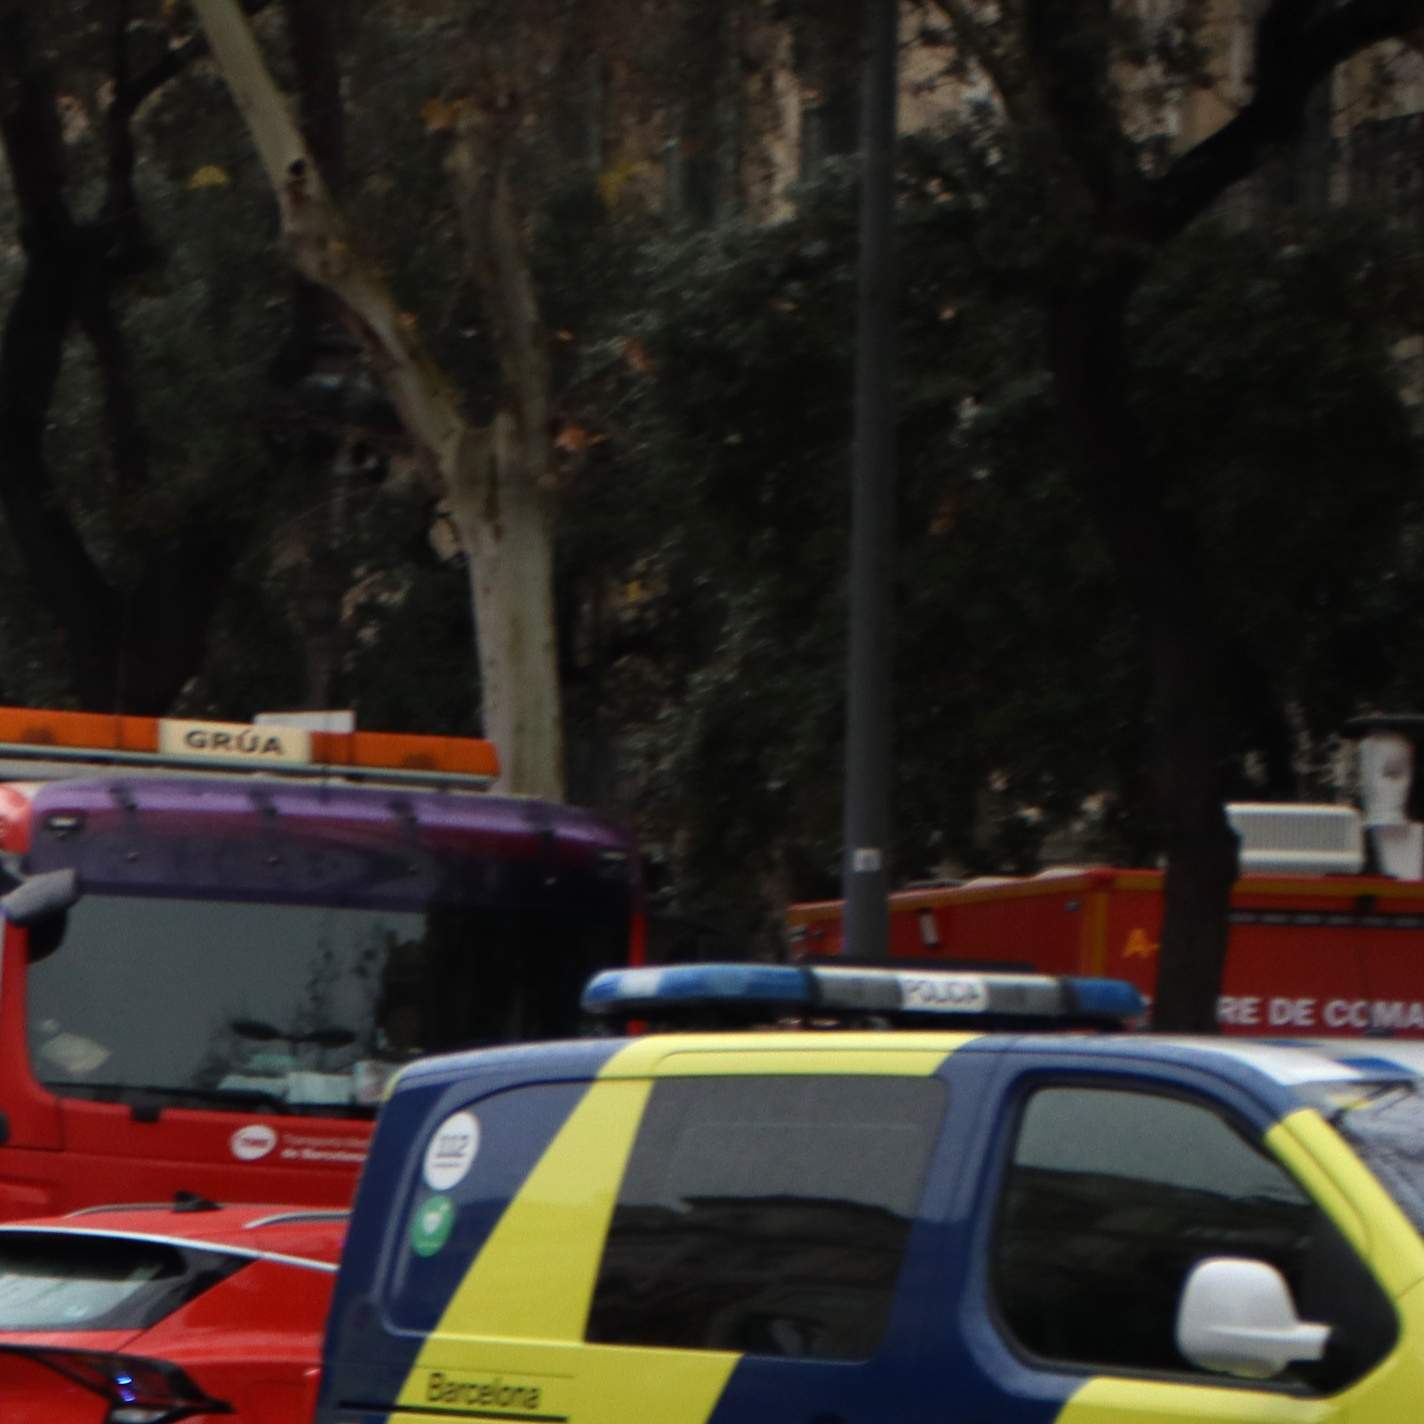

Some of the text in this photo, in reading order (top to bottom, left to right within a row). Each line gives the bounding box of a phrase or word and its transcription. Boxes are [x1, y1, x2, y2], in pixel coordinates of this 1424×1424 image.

[184, 729, 284, 756] GRÚA
[1268, 997, 1316, 1028] DE
[427, 1372, 542, 1410] Barcelona
